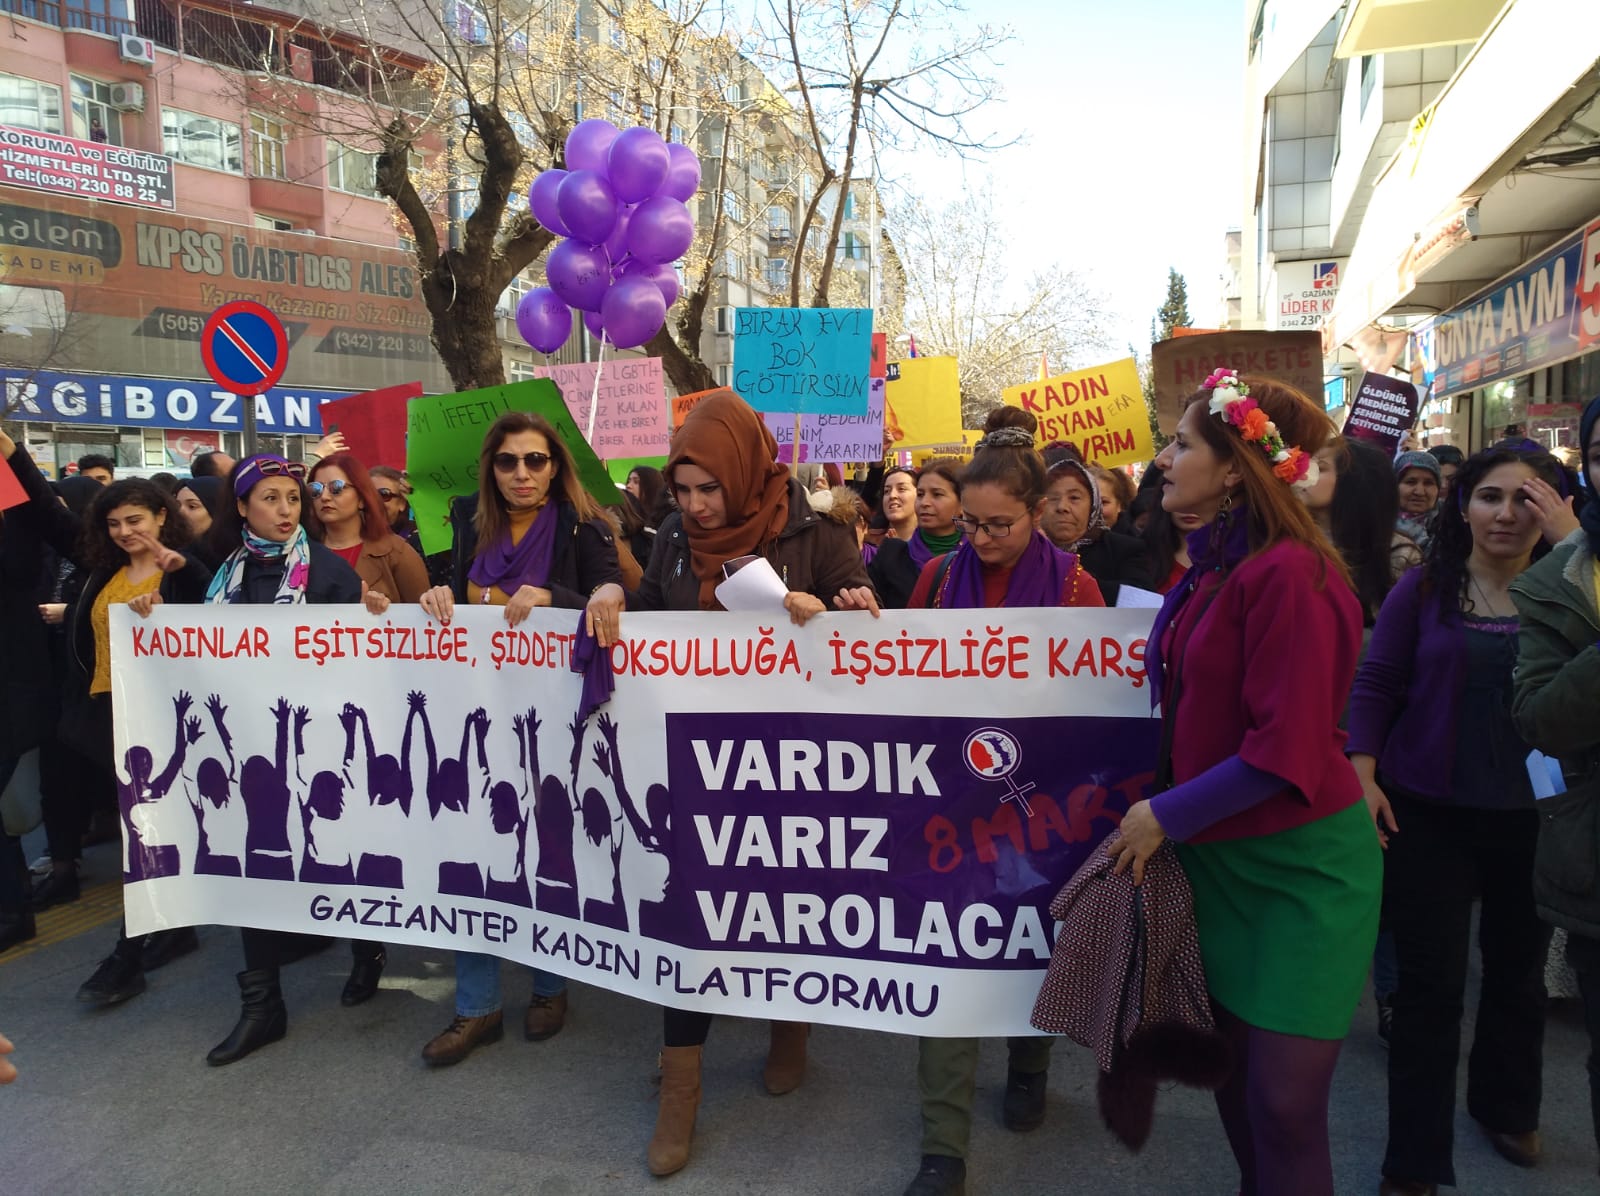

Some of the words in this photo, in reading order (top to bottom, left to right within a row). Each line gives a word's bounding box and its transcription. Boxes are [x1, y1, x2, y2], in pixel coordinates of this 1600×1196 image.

[80, 148, 102, 160] ve
[105, 152, 168, 174] EĞİTİM
[80, 178, 110, 194] 230
[114, 185, 134, 199] 88
[138, 188, 157, 203] 25
[0, 213, 103, 250] alem
[136, 222, 225, 277] KPSS
[231, 234, 299, 286] ÖABT
[303, 253, 351, 292] DGS
[359, 261, 415, 299] ALES
[0, 253, 95, 276] ADEMİ
[265, 290, 350, 321] Kazanan
[355, 302, 384, 325] Siz
[1281, 298, 1318, 314] LİDER
[1500, 256, 1566, 344] AVM
[735, 309, 803, 338] BIRAK
[767, 341, 818, 371] BOK
[735, 370, 870, 398] GÖTÜRSÜN
[1020, 374, 1110, 414] KADIN
[1362, 384, 1408, 406] ÖLDÜRÜL
[617, 400, 658, 415] KALAN
[1038, 406, 1106, 442] İSYAN
[814, 442, 882, 460] KARARIM!
[132, 625, 270, 659] KADINLAR
[294, 619, 477, 668] EŞİTSİZLİĞE,
[831, 626, 1030, 685] İŞSİZLİĞE
[1049, 637, 1148, 688] KARŞ
[691, 739, 942, 797] VARDIK
[693, 815, 889, 872] VARIZ
[925, 814, 962, 873] 8
[695, 891, 1064, 961] VAROLACA
[310, 894, 518, 944] GAZİANTEP
[531, 923, 641, 981] KADIN
[656, 956, 940, 1018] PLATFORMU
